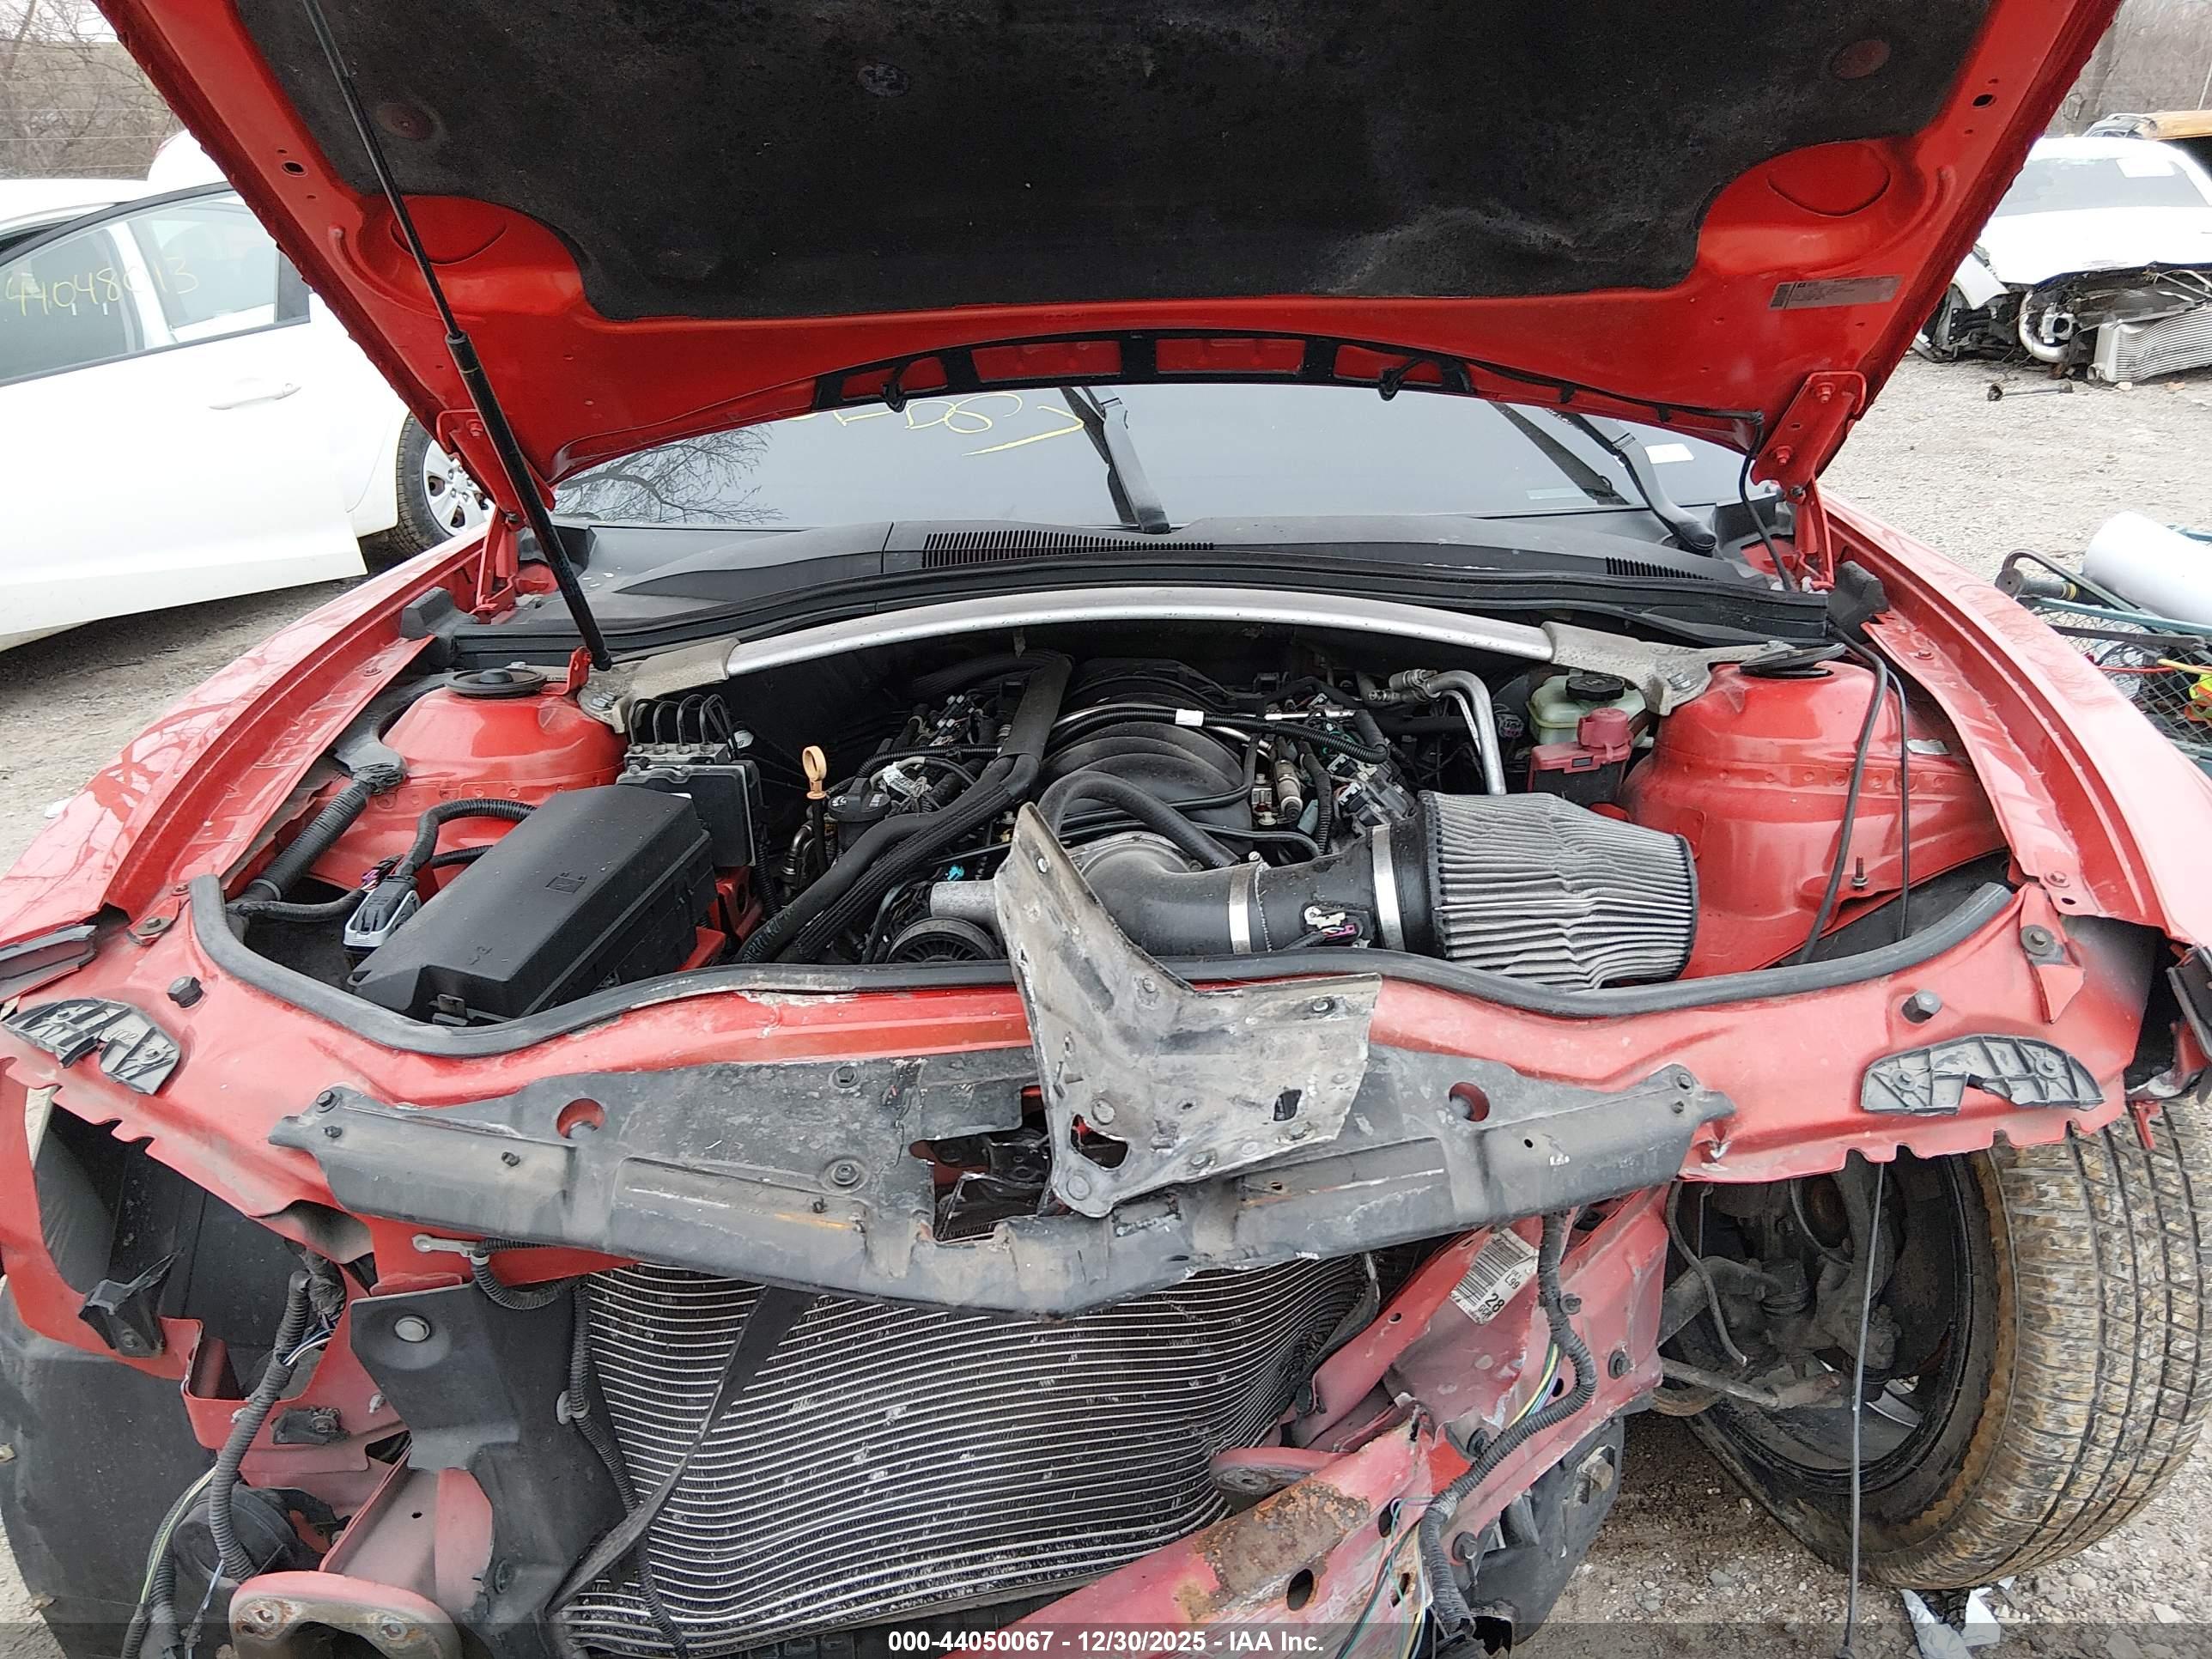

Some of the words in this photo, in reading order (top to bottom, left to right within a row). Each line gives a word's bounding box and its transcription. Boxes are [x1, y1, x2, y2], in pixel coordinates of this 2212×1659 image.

[6, 258, 199, 316] 44048013
[1505, 1274, 1521, 1289] L99
[1485, 1292, 1504, 1312] 28
